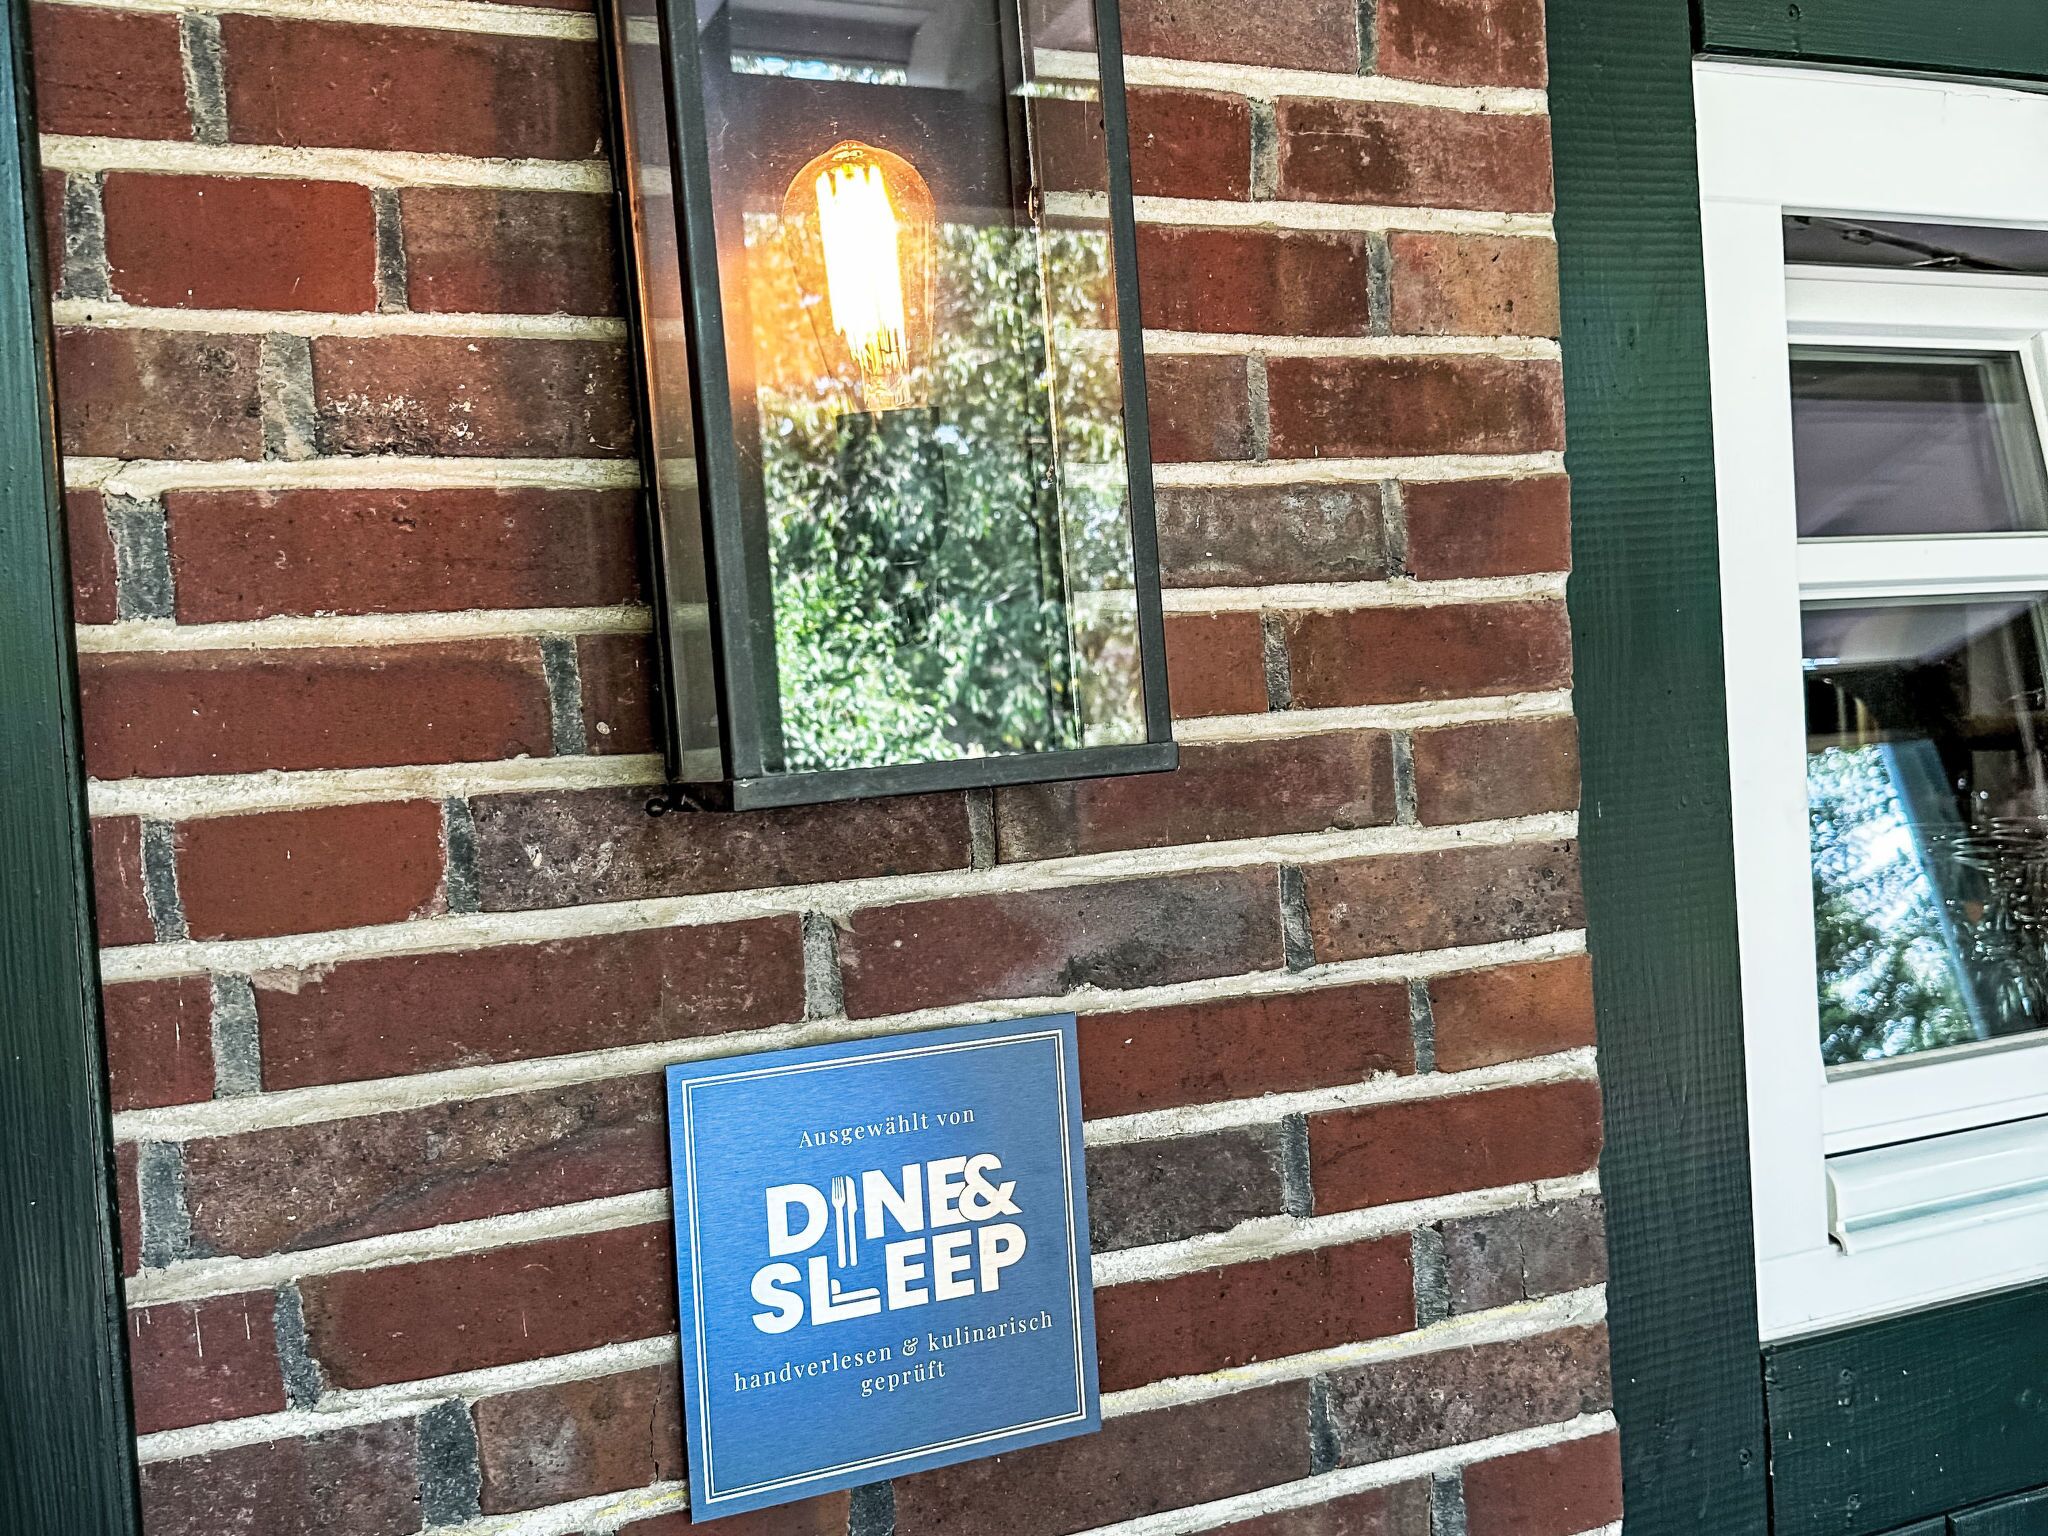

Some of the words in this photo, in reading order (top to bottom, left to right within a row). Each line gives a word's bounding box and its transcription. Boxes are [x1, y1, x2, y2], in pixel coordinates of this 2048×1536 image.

[798, 1111, 929, 1149] Ausgewählt
[936, 1108, 976, 1128] von
[750, 1222, 1027, 1335] SLEEP
[733, 1346, 893, 1393] handverlesen
[901, 1337, 919, 1358] &
[927, 1310, 1054, 1352] kulinarisch
[860, 1360, 947, 1398] geprüft
